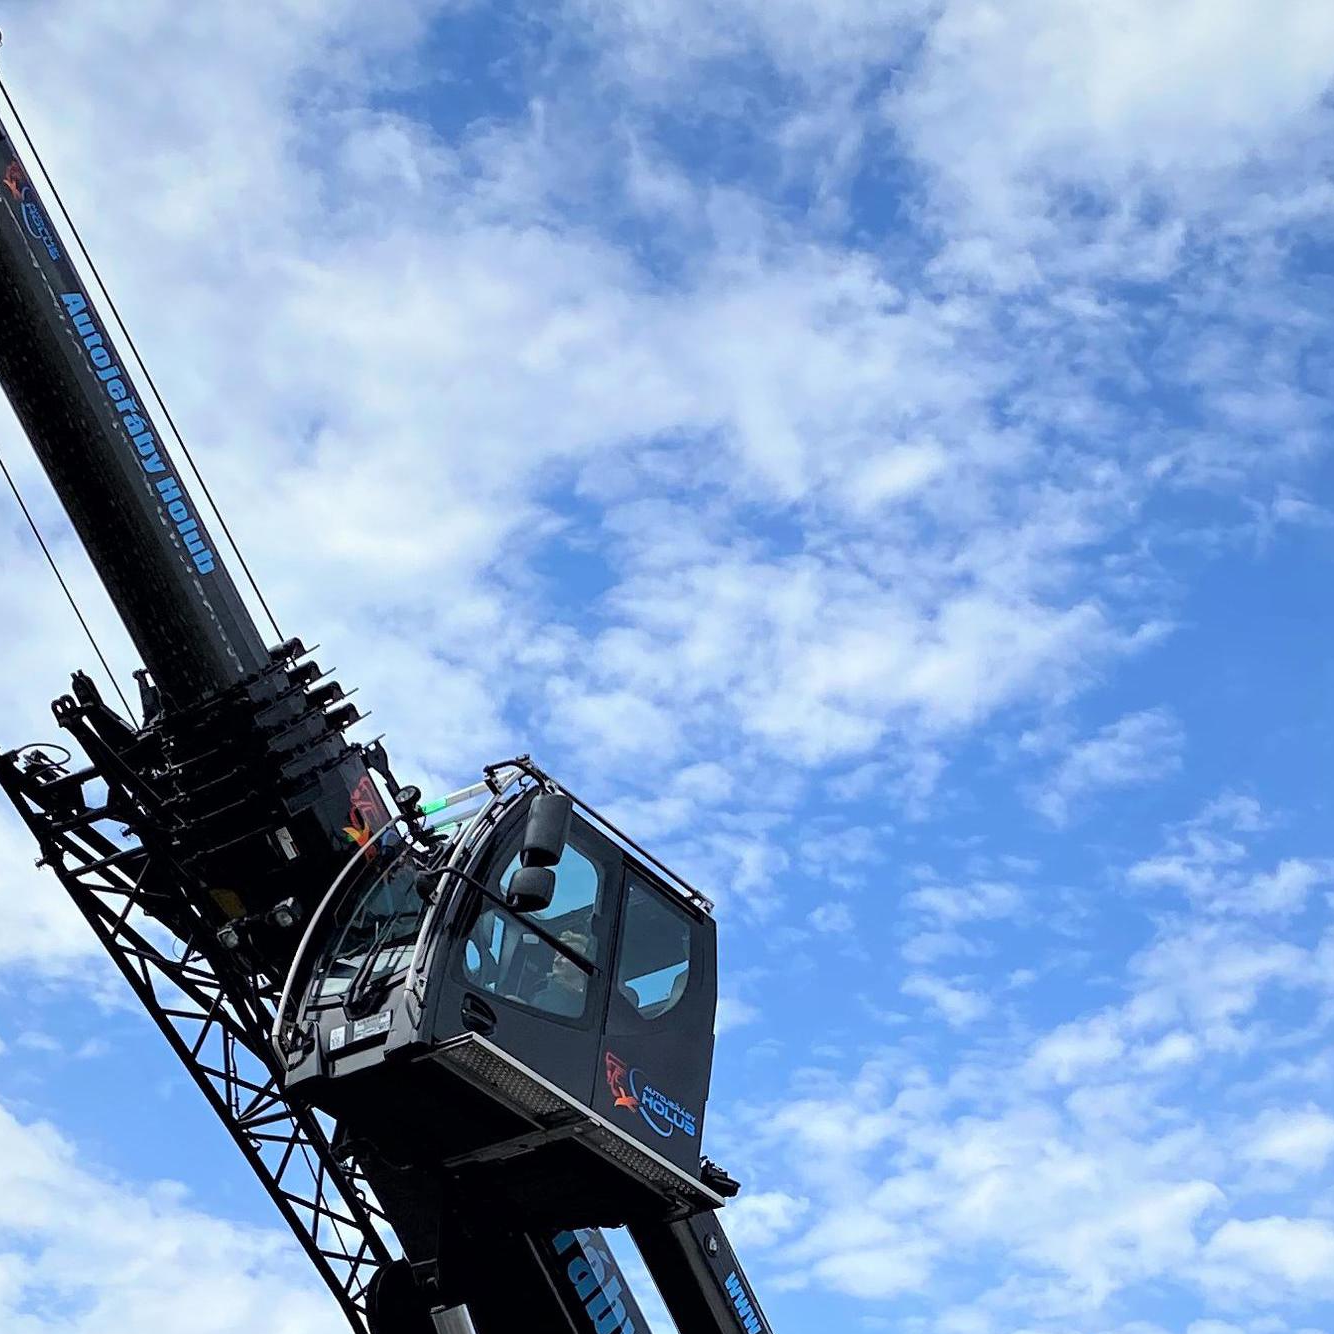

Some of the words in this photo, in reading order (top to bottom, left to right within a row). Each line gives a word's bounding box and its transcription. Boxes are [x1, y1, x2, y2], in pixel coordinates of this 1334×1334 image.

[60, 292, 166, 474] Autojeřáby
[155, 476, 215, 575] Holub
[641, 1091, 696, 1137] HOLUB
